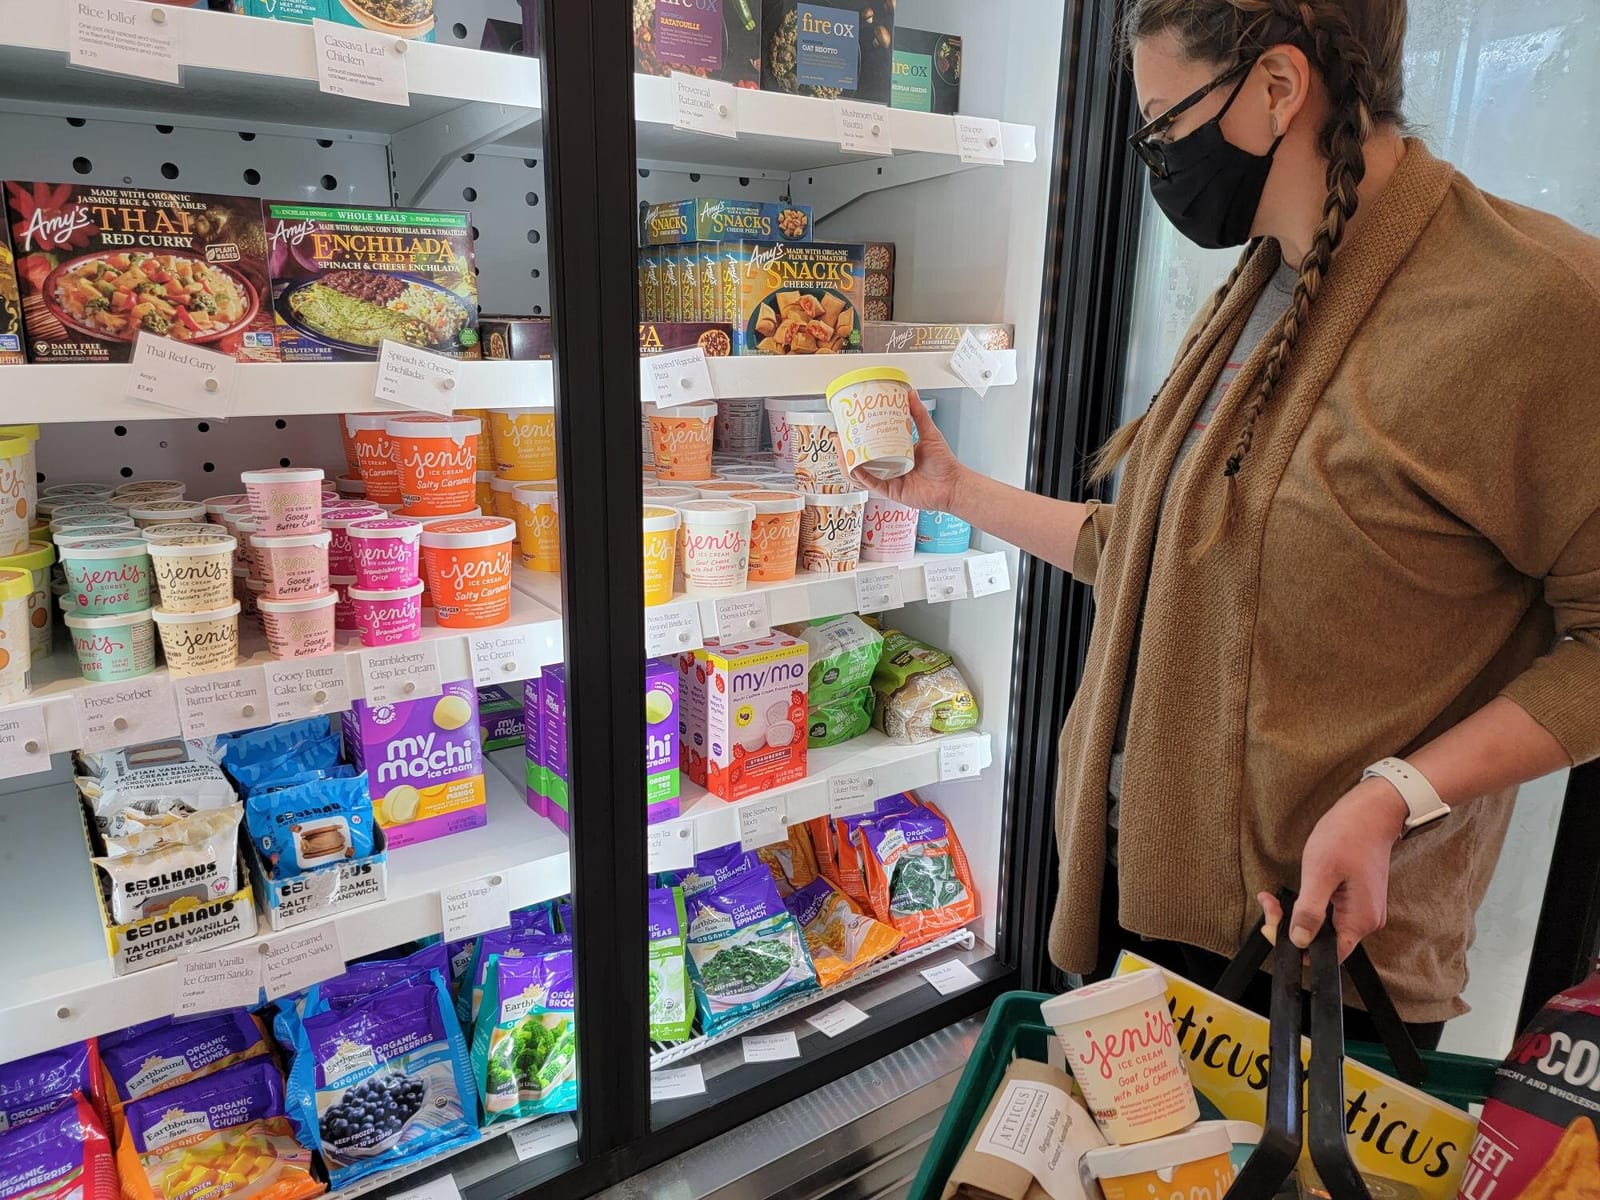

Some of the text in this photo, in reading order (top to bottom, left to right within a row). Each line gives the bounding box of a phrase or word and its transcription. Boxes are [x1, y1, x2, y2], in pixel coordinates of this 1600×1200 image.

[78, 3, 136, 25] Rice Jollof
[660, 17, 701, 31] RATATOUILLE
[802, 12, 855, 38] fire ox
[324, 34, 385, 57] Cassava Leaf
[326, 50, 365, 67] Chicken
[911, 66, 928, 77] ox
[678, 95, 715, 111] Ratatouille
[77, 195, 207, 210] JASMINE RICE VEGETABLES
[91, 188, 191, 202] MADE WITH ORGANIC
[92, 206, 194, 235] THAI
[337, 211, 406, 223] WHOLE MEALS
[700, 201, 726, 223] Amy's
[20, 205, 91, 251] Amy's
[269, 218, 316, 249] Amy's
[650, 215, 688, 238] SNACKS
[713, 213, 772, 236] SNACKS
[101, 233, 193, 248] RED CURRY
[311, 233, 456, 263] ENCHILADA
[318, 261, 460, 273] SPINACH CHEESE ENCHILADA
[745, 242, 785, 278] Amy's
[766, 261, 854, 290] SNACKS
[783, 280, 838, 289] CHEESE PIZZA
[885, 327, 915, 353] Amy's
[915, 326, 962, 346] PIZZA
[80, 343, 102, 351] FREE
[145, 343, 216, 373] Thai Red Curry
[387, 350, 455, 376] Spinach Cheese
[386, 362, 425, 382] Enchiladas
[404, 445, 477, 478] jeni's
[417, 475, 472, 491] Salty Caramel
[683, 529, 747, 560] jeni's
[354, 544, 412, 567] jeni's
[76, 564, 146, 592] jeni's
[161, 561, 229, 588] jeni's
[441, 551, 512, 590] jeni's
[482, 577, 503, 585] CREAM
[94, 588, 130, 606] Frosé
[455, 591, 479, 602] Salty
[364, 603, 420, 628] jeni's
[475, 633, 526, 652] Salty Caramel
[368, 651, 425, 670] Brambleberry
[489, 648, 515, 661] Cream
[272, 665, 335, 684] Gooey Butter
[369, 662, 435, 681] Crisp Ice Cream
[184, 678, 243, 695] Salted Peanut
[273, 676, 344, 697] Cake Ice Cream
[83, 688, 153, 709] Frose Sorbet
[186, 687, 257, 708] Butter Ice Cream
[387, 732, 435, 761] my
[378, 740, 473, 783] mochi
[750, 750, 785, 765] STRAWBERRY
[427, 763, 473, 779] ice cream
[906, 825, 933, 837] ORGANIC
[125, 862, 218, 893] COOLHAUS
[714, 866, 729, 876] CUT
[717, 864, 748, 883] ORGANIC
[126, 872, 218, 899] AWESOME CREAM
[732, 904, 746, 914] CUT
[734, 902, 767, 920] ORGANIC
[736, 910, 767, 928] SPINACH
[126, 900, 235, 942] COOLHAUS
[124, 915, 239, 955] TAHITIAN VANILLA
[126, 923, 241, 964] ICE CREAM SANDWICH
[290, 934, 323, 952] Caramel
[651, 928, 672, 938] PEAS
[696, 930, 731, 943] ORGANIC
[184, 956, 245, 973] Tahitian Vanilla
[282, 942, 333, 968] Cream Sando
[198, 967, 253, 984] Cream Sando
[186, 1034, 228, 1056] ORGANIC
[375, 1032, 417, 1053] ORGANIC
[378, 1034, 433, 1062] BLUEBERRIES
[1079, 1011, 1174, 1080] jeni's
[189, 1044, 224, 1064] MANGO
[193, 1048, 231, 1069] CHUNKS
[326, 1050, 373, 1073] Earthbound
[1117, 1048, 1164, 1071] ICE CREAM
[129, 1059, 185, 1091] Earthbound
[151, 1073, 168, 1085] Farm
[332, 1067, 374, 1089] ORGANIC
[1118, 1060, 1168, 1087] Goat Cheese
[1113, 1066, 1180, 1104] with Red Cherries
[1526, 1078, 1548, 1091] AND
[10, 1101, 58, 1122] ORGANIC
[209, 1096, 253, 1114] ORGANIC
[211, 1107, 248, 1121] MANGO
[213, 1114, 250, 1129] CHUNKS
[1000, 1091, 1030, 1142] ATTICUS
[146, 1115, 206, 1142] Earthbound
[169, 1128, 187, 1139] Farm
[333, 1128, 375, 1145] KEEP FROZEN
[155, 1133, 204, 1155] ORGANIC
